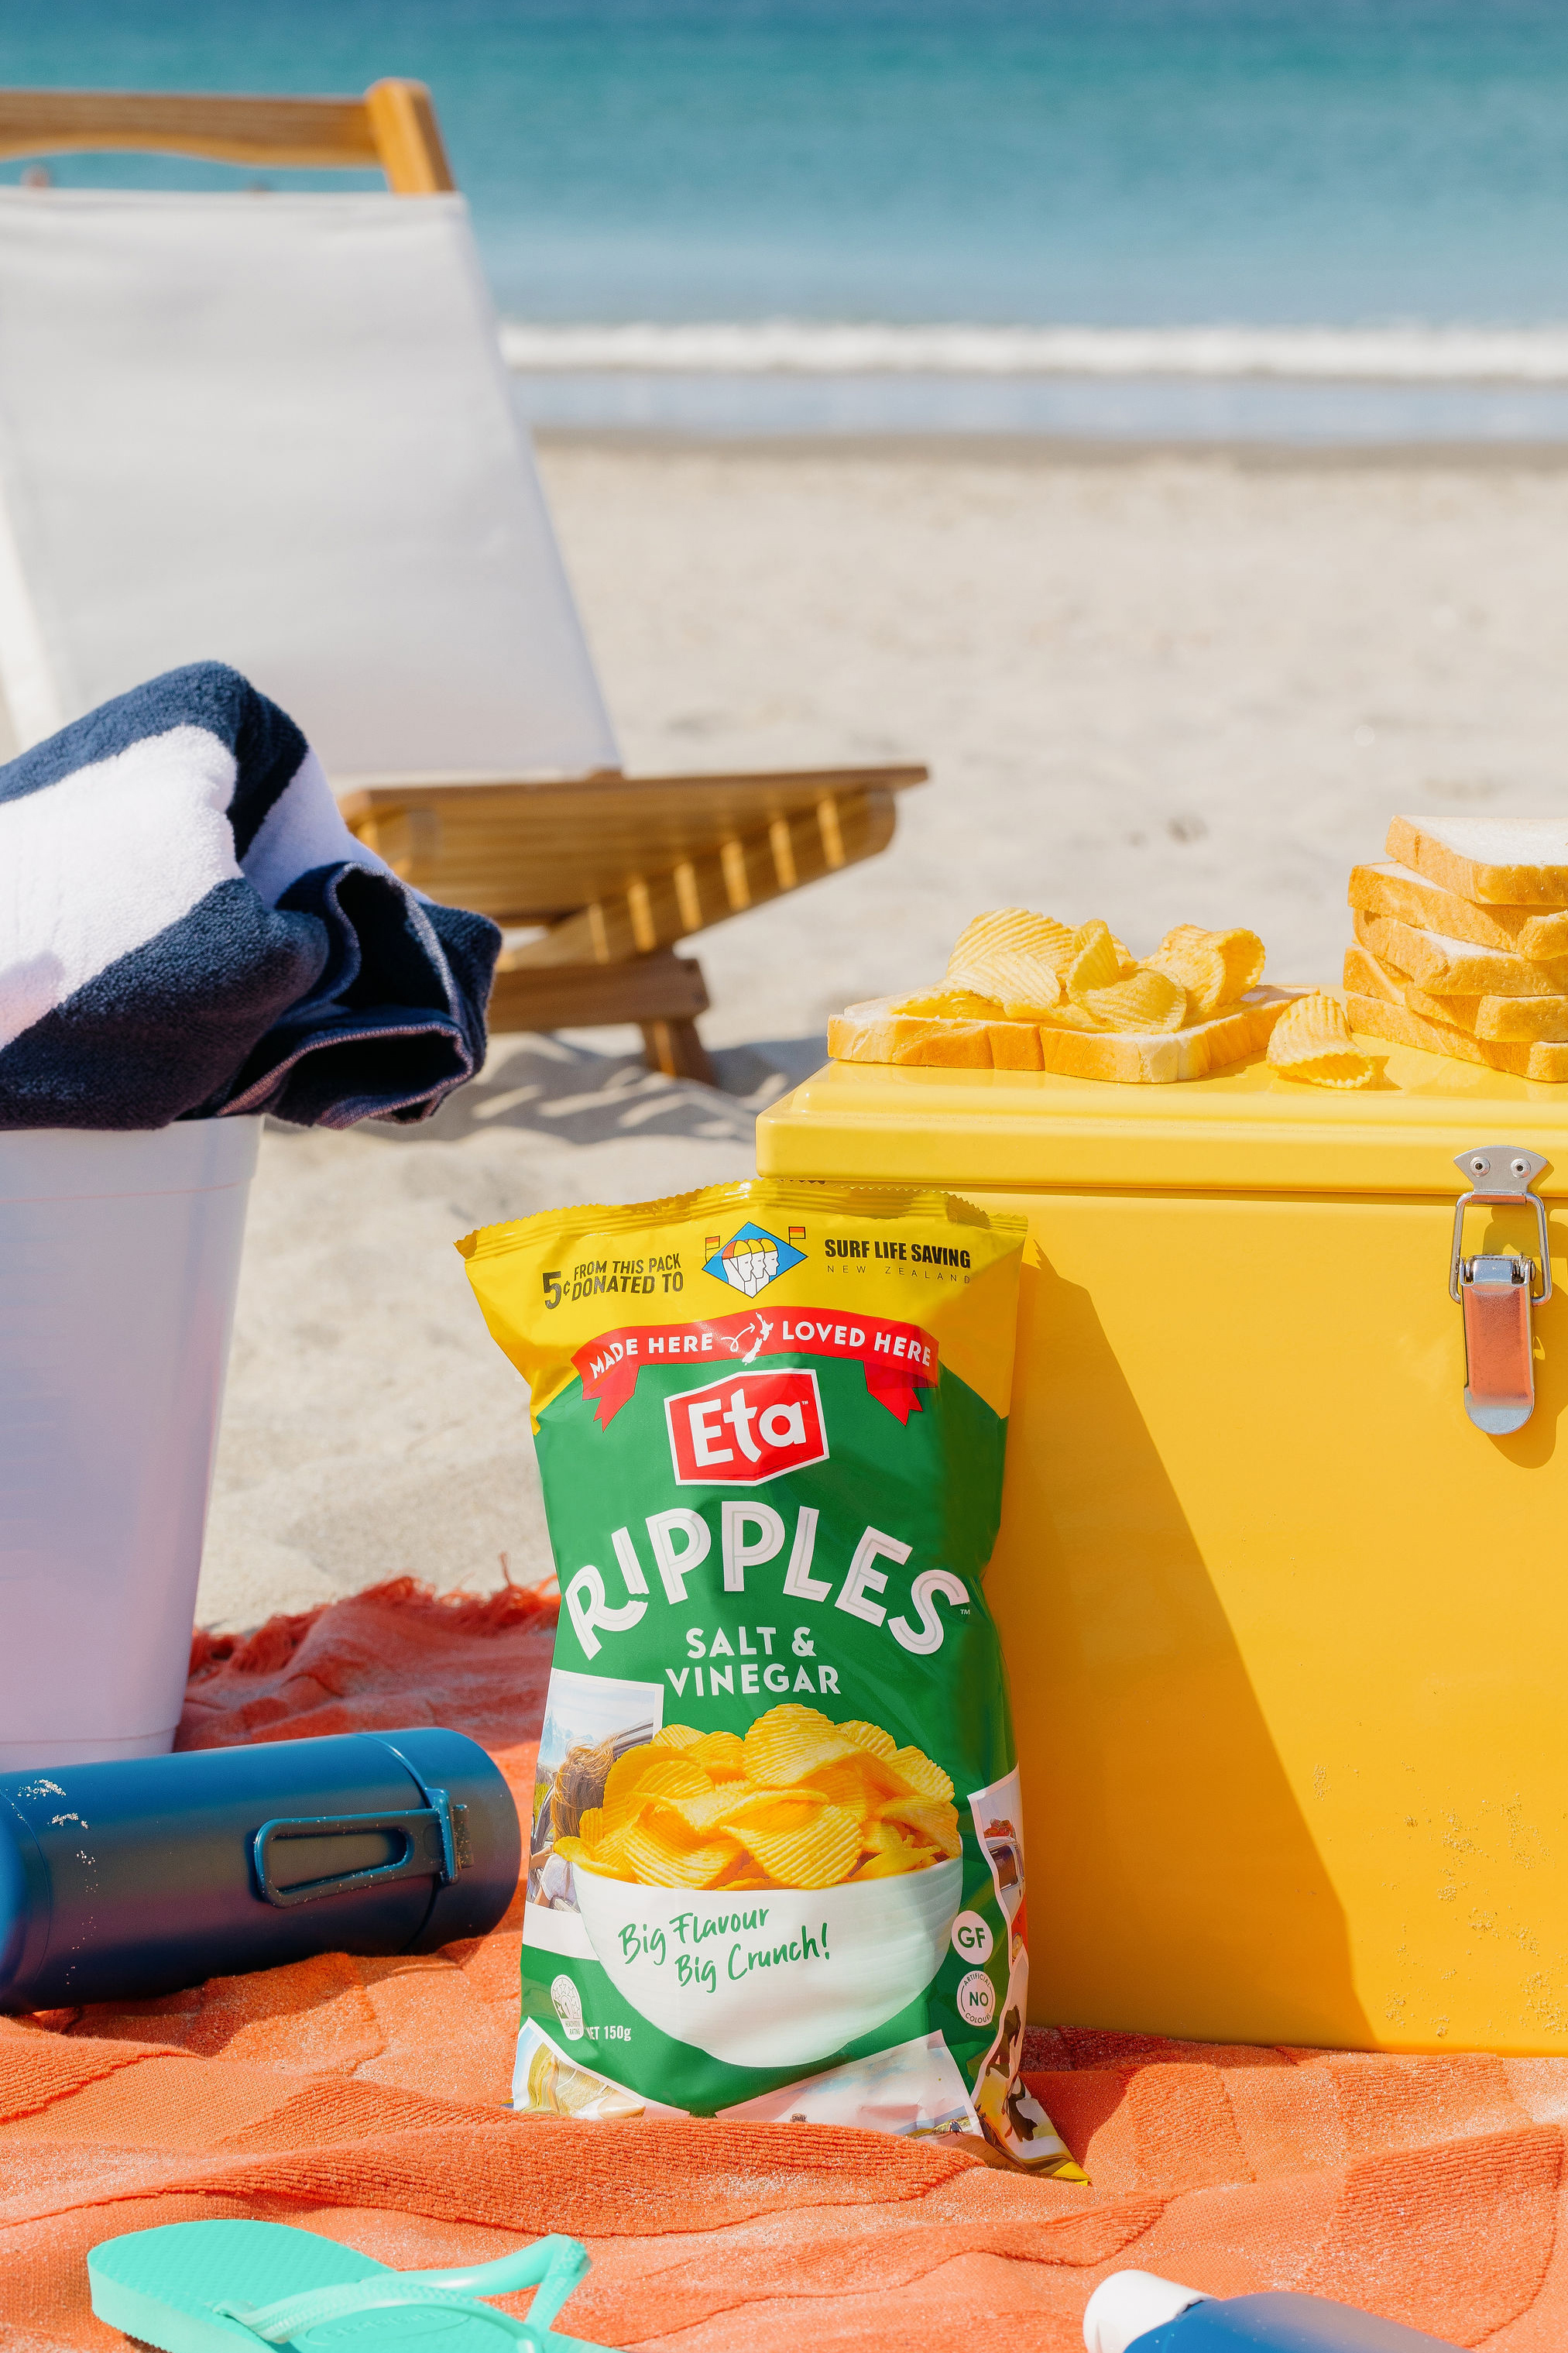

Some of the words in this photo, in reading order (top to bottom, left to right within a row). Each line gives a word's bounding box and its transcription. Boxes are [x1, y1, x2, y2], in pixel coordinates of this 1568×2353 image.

[574, 1260, 608, 1281] FROM
[612, 1259, 644, 1274] THIS
[649, 1253, 681, 1273] PACK
[825, 1239, 870, 1258] SURF
[874, 1241, 907, 1261] LIFE
[911, 1244, 971, 1269] SAVING
[543, 1270, 571, 1309] 5¢
[571, 1275, 655, 1301] DONATED
[662, 1271, 684, 1293] TO
[827, 1265, 866, 1274] NEW
[885, 1266, 970, 1284] ZEALAND
[589, 1338, 638, 1379] MADE
[647, 1332, 713, 1354] HERE
[782, 1321, 866, 1347] LOVED
[873, 1331, 932, 1368] HERE
[688, 1388, 807, 1468] Eta
[565, 1500, 970, 1661] RIPPLES
[687, 1626, 777, 1660] SALT
[791, 1626, 817, 1657] &
[665, 1664, 842, 1698] VINEGAR
[618, 1923, 666, 1966] Big
[669, 1908, 770, 1944] Flavour
[957, 1926, 986, 1949] GF
[674, 1954, 716, 1994] Big
[728, 1922, 830, 1980] Crunch!
[963, 1973, 990, 1987] ARTIFICIAL
[969, 1991, 989, 2007] NO
[604, 2025, 632, 2042] 150g
